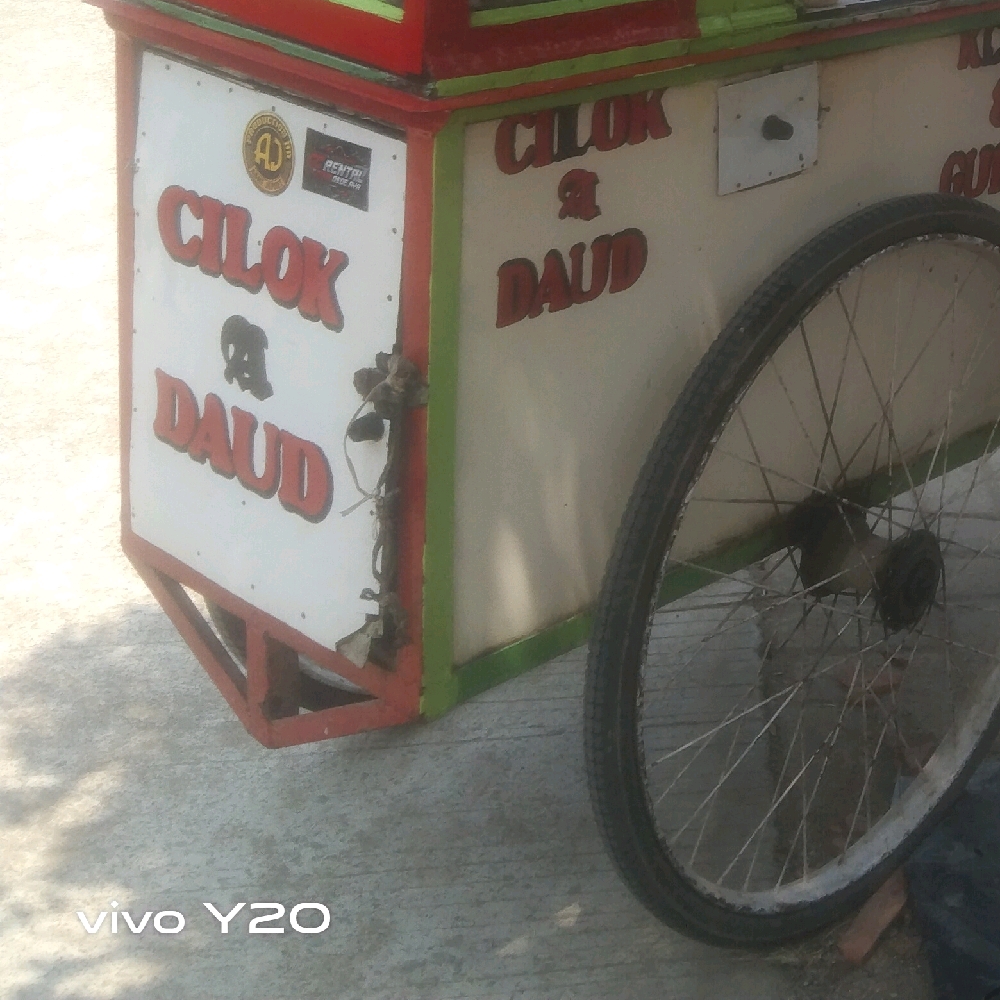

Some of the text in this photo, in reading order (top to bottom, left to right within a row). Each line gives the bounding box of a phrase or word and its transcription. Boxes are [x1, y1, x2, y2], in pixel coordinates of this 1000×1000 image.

[323, 159, 364, 184] RENTAL
[494, 88, 673, 176] CILOK
[157, 184, 349, 333] CILOK
[496, 227, 648, 329] DAUD
[153, 367, 334, 523] DAUD
